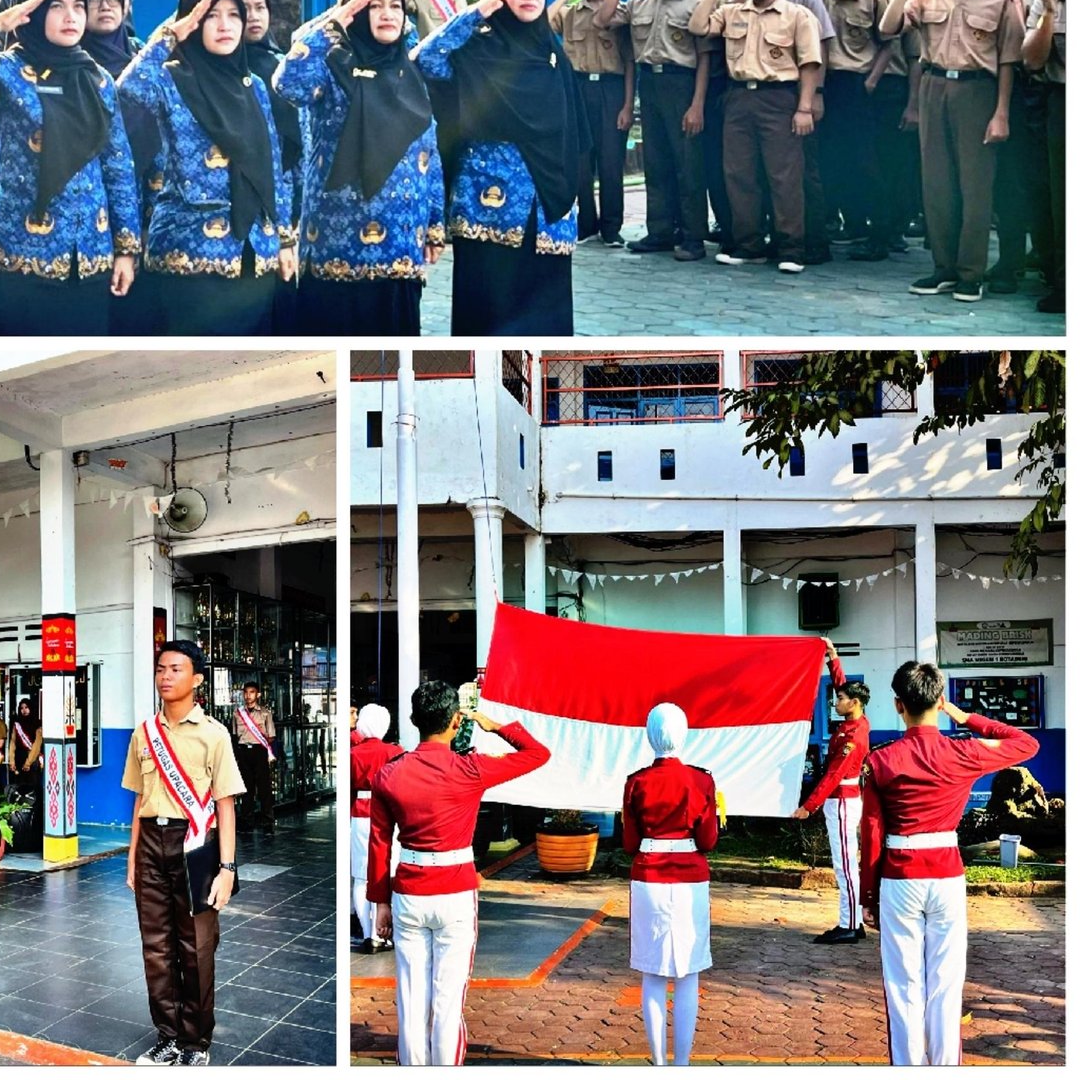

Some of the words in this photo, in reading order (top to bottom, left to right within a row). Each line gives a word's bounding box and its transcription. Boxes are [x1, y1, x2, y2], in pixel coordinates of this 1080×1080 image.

[956, 630, 1000, 641] MADING
[1001, 629, 1033, 640] BRISK
[152, 737, 174, 771] PETUGAS
[168, 770, 195, 807] UPACARA
